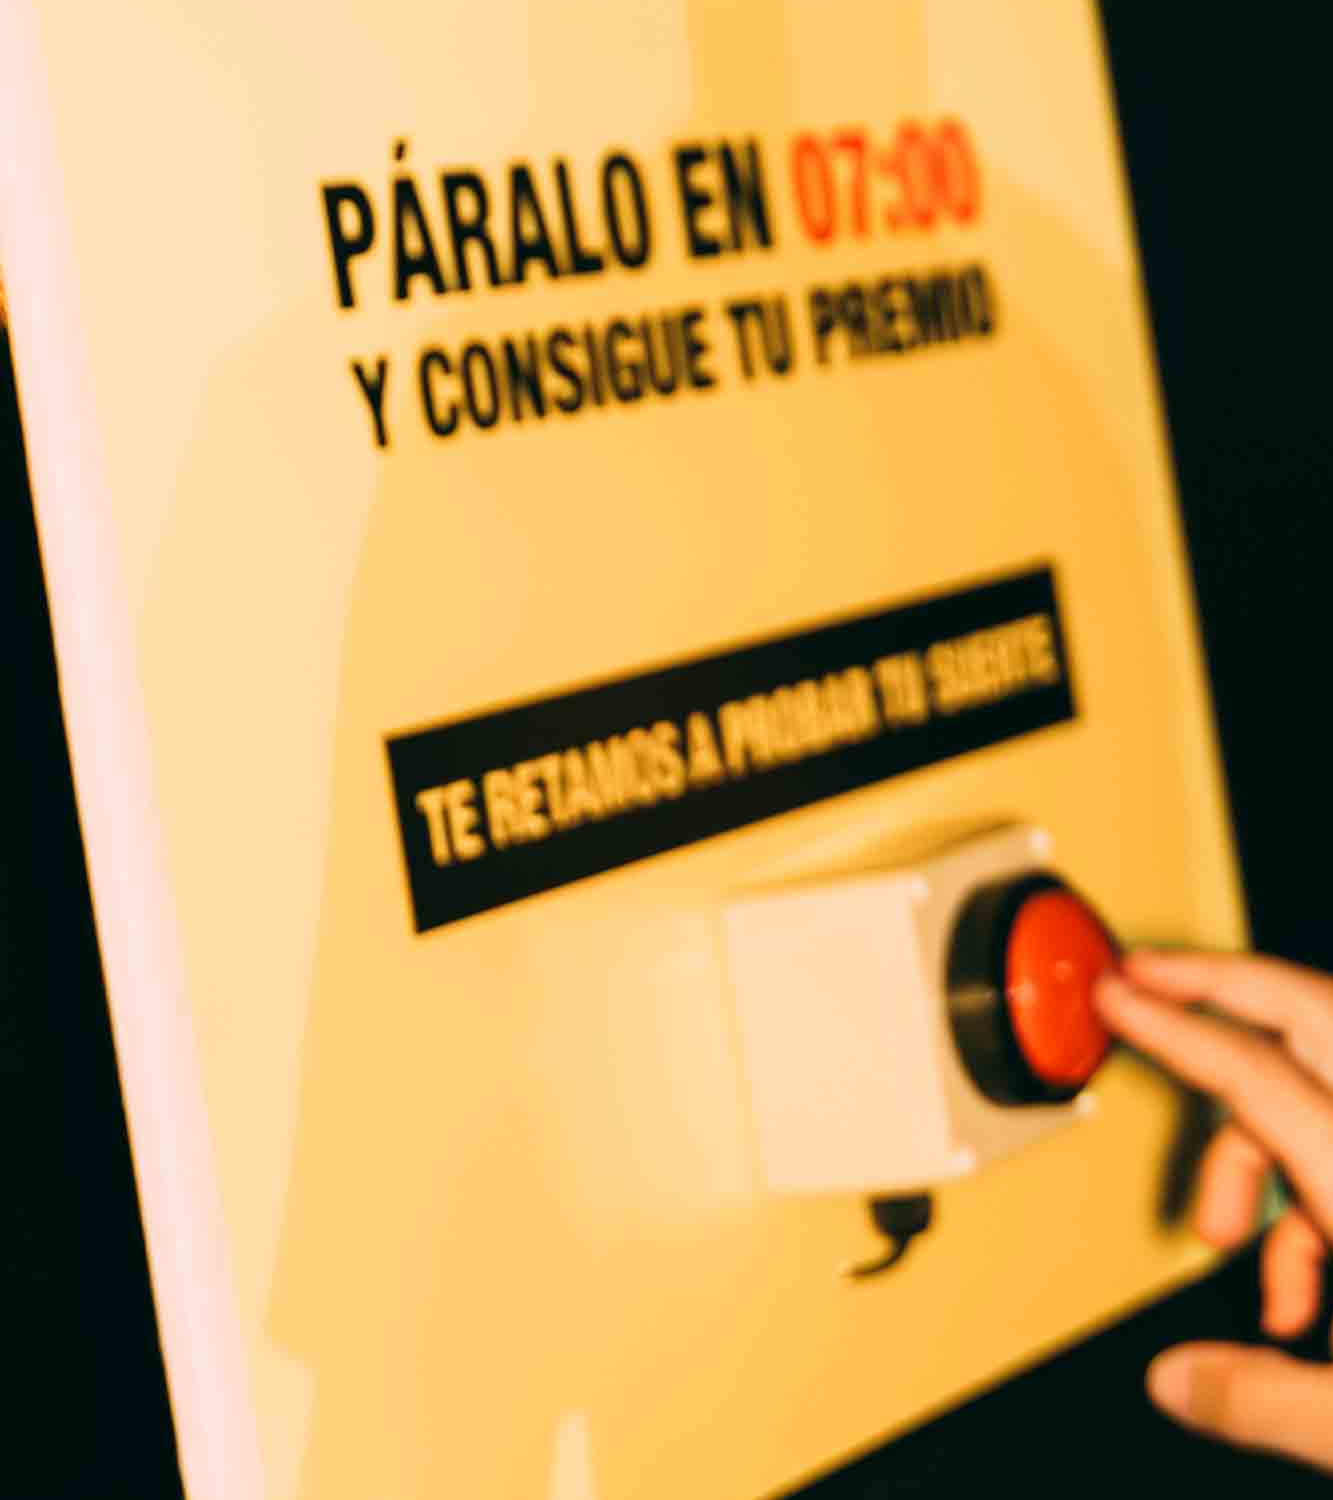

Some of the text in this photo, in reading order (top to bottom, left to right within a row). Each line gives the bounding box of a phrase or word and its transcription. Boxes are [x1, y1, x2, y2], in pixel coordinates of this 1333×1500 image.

[322, 116, 982, 309] PÁRALO EN 07:00
[352, 262, 999, 448] Y CONSIGUE TU PREMIO
[417, 778, 485, 867] TE
[484, 721, 686, 851] RETAMOS
[687, 712, 723, 787] A
